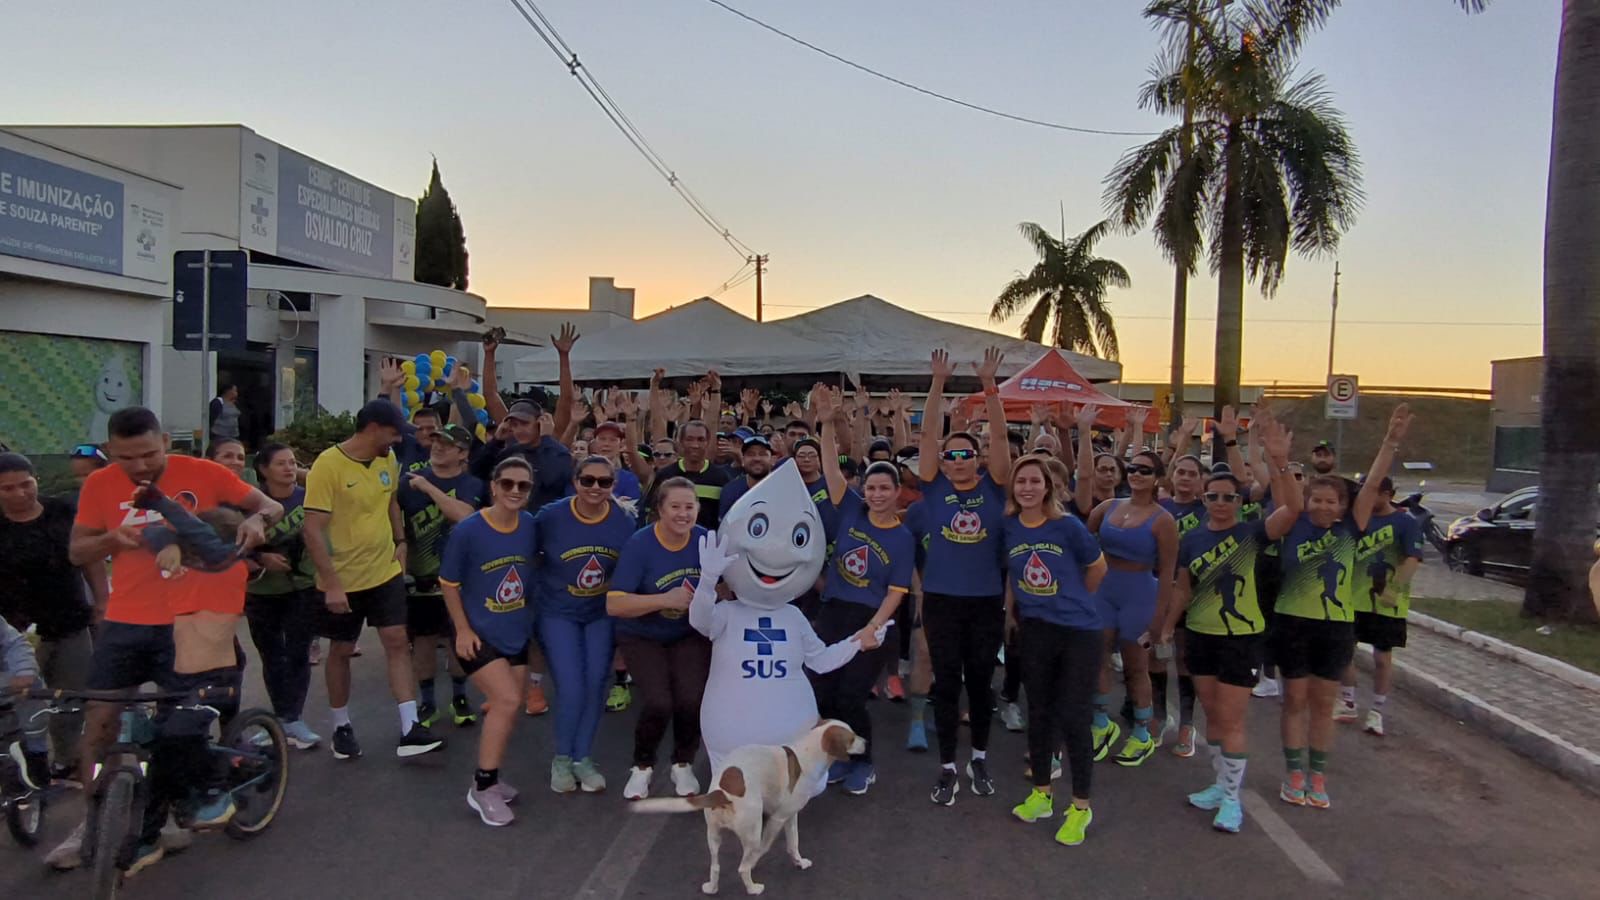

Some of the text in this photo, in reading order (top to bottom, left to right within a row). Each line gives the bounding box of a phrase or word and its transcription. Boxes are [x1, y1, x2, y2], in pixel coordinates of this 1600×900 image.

[17, 175, 115, 219] IMUNIZAÇÃO
[297, 183, 354, 222] ESPECIALIDADES
[9, 203, 49, 225] SOUZA
[305, 210, 349, 249] OSVALDO
[349, 225, 373, 257] CRUZ
[1337, 382, 1348, 397] E
[741, 659, 788, 679] SUS
